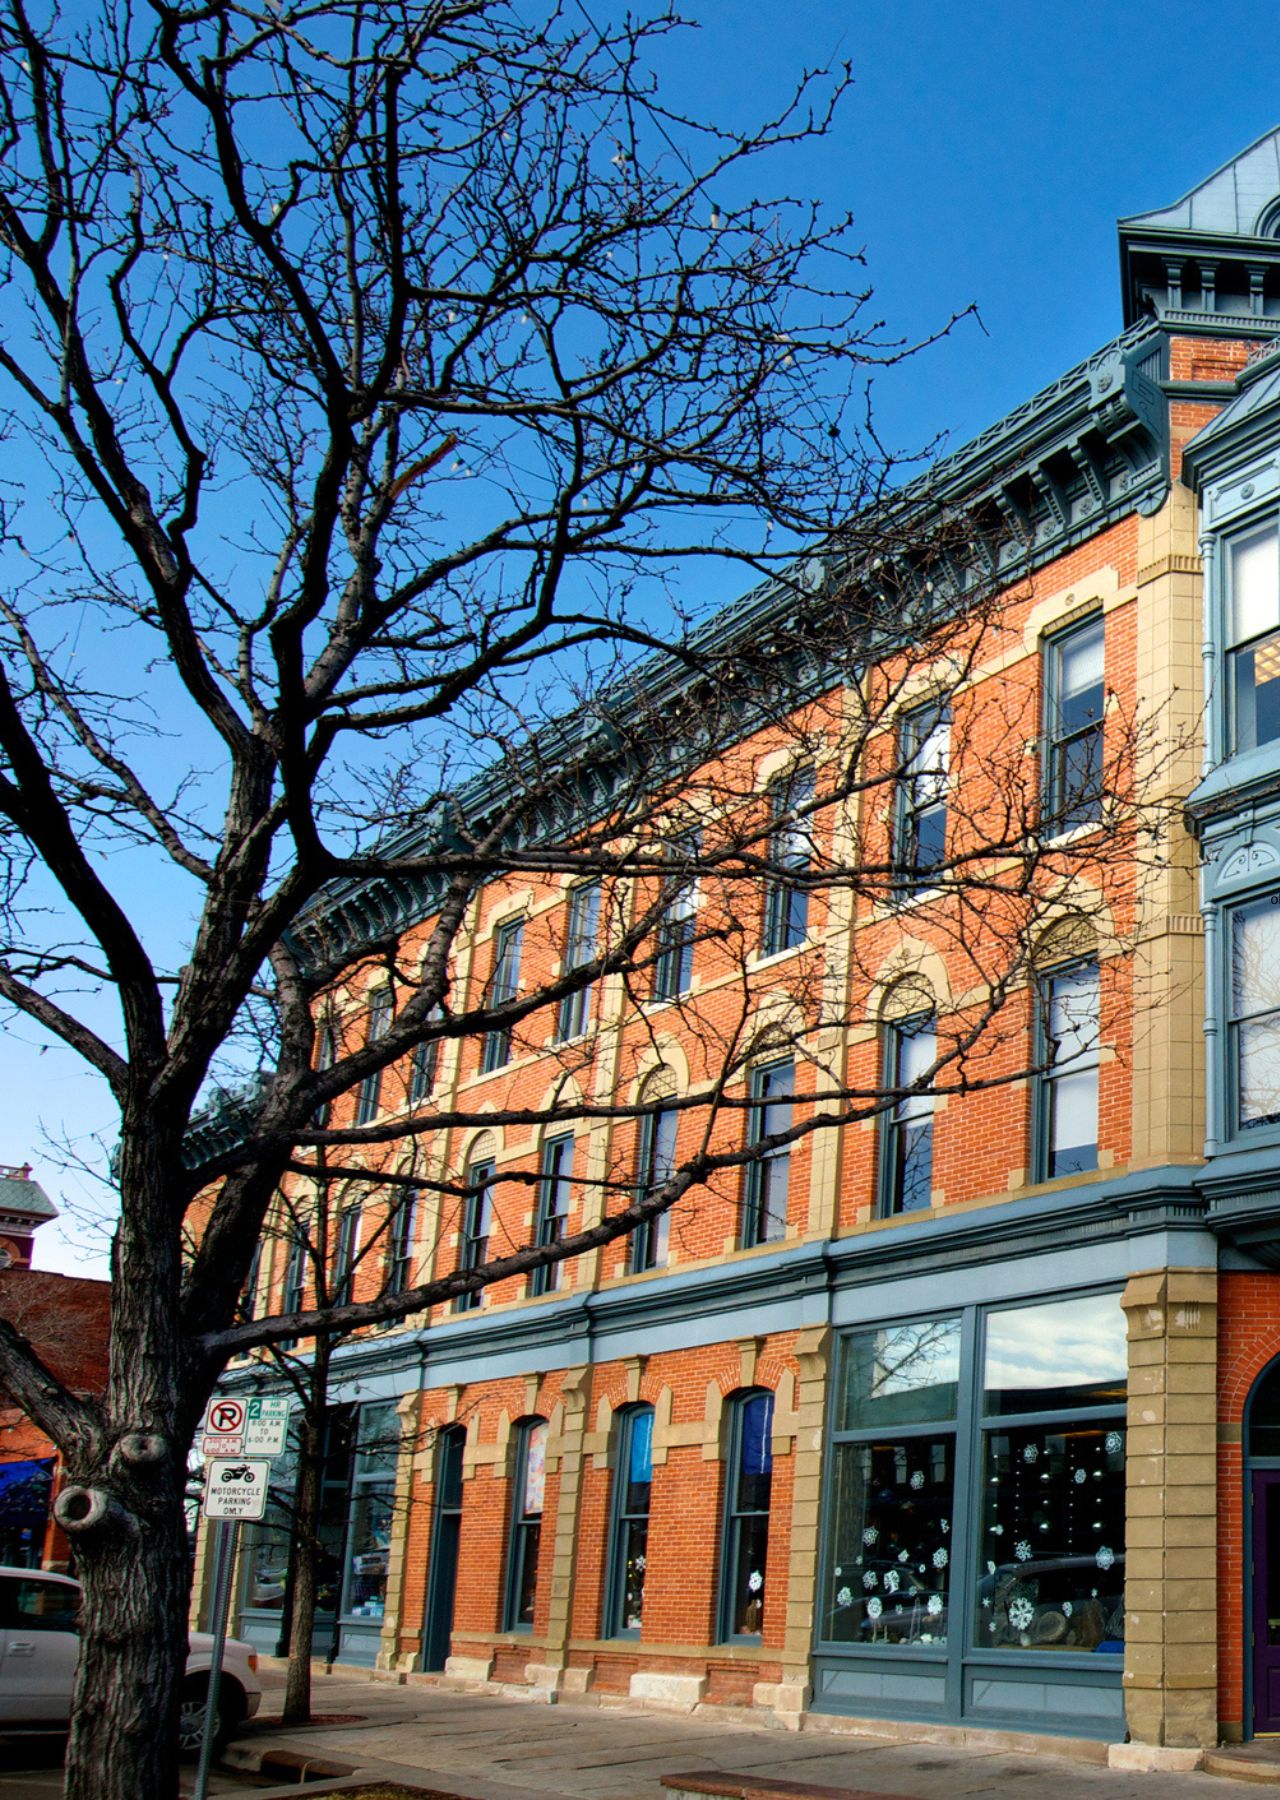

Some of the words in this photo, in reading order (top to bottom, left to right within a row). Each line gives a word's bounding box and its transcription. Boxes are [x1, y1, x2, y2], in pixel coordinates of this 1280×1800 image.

[249, 1402, 261, 1417] 2
[262, 1409, 286, 1417] PARKING
[211, 1487, 261, 1496] MOTORCYCLE
[217, 1497, 252, 1505] PARKING
[223, 1507, 244, 1515] ONLY
